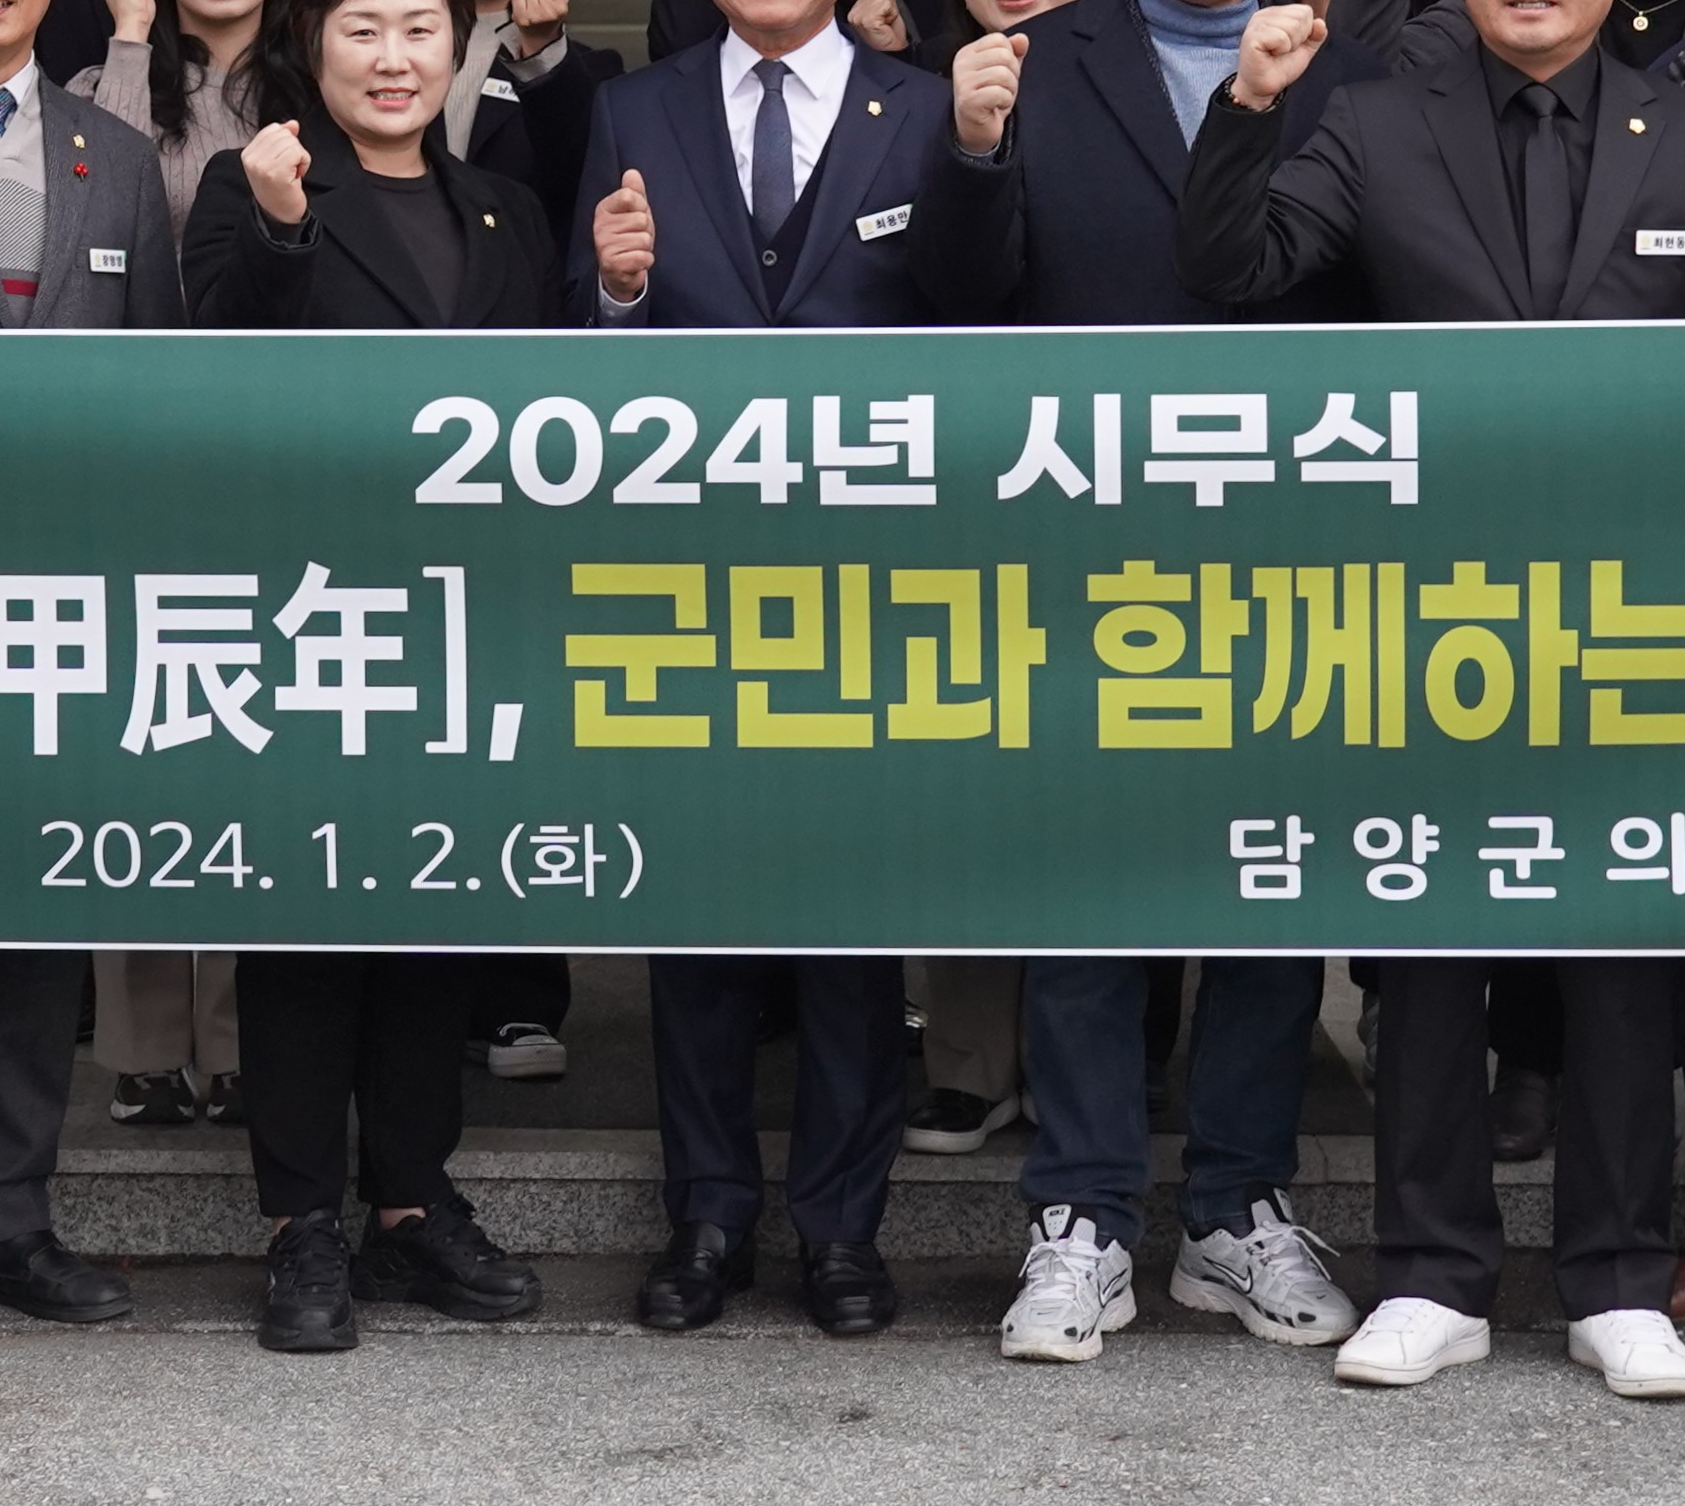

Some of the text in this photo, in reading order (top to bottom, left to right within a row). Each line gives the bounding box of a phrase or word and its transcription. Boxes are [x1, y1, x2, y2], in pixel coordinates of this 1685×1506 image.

[876, 210, 908, 229] 최용만
[411, 390, 1420, 507] 2024년 시무식
[565, 563, 1046, 748] 군민과
[41, 820, 274, 890] 2024.
[312, 821, 377, 890] 1.
